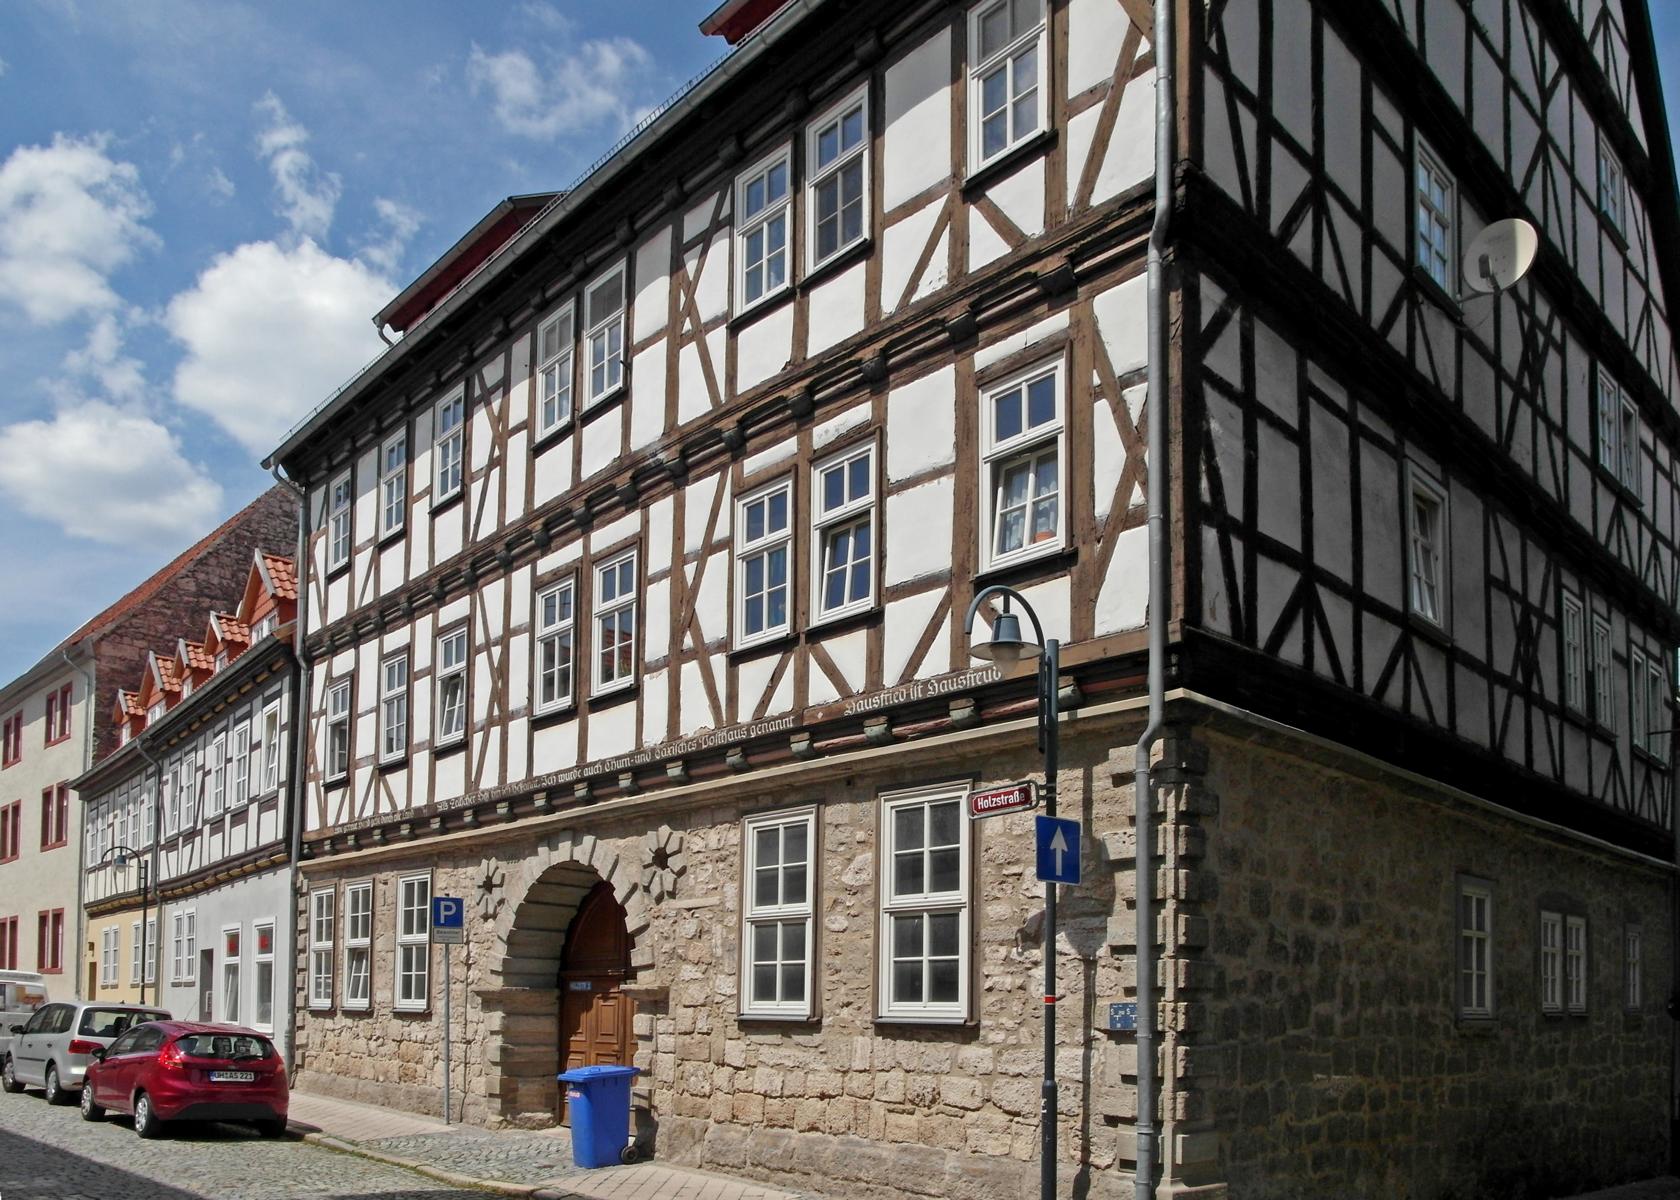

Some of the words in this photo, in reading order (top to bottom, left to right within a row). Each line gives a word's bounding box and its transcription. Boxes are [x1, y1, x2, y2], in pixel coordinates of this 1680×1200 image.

[843, 690, 906, 716] Hausfried
[910, 683, 924, 701] ist
[926, 665, 1002, 698] Hausfreud
[558, 766, 581, 783] wurde
[583, 761, 603, 777] auch
[749, 714, 795, 737] genannt
[977, 790, 1025, 810] Holzstraße
[440, 901, 457, 924] P
